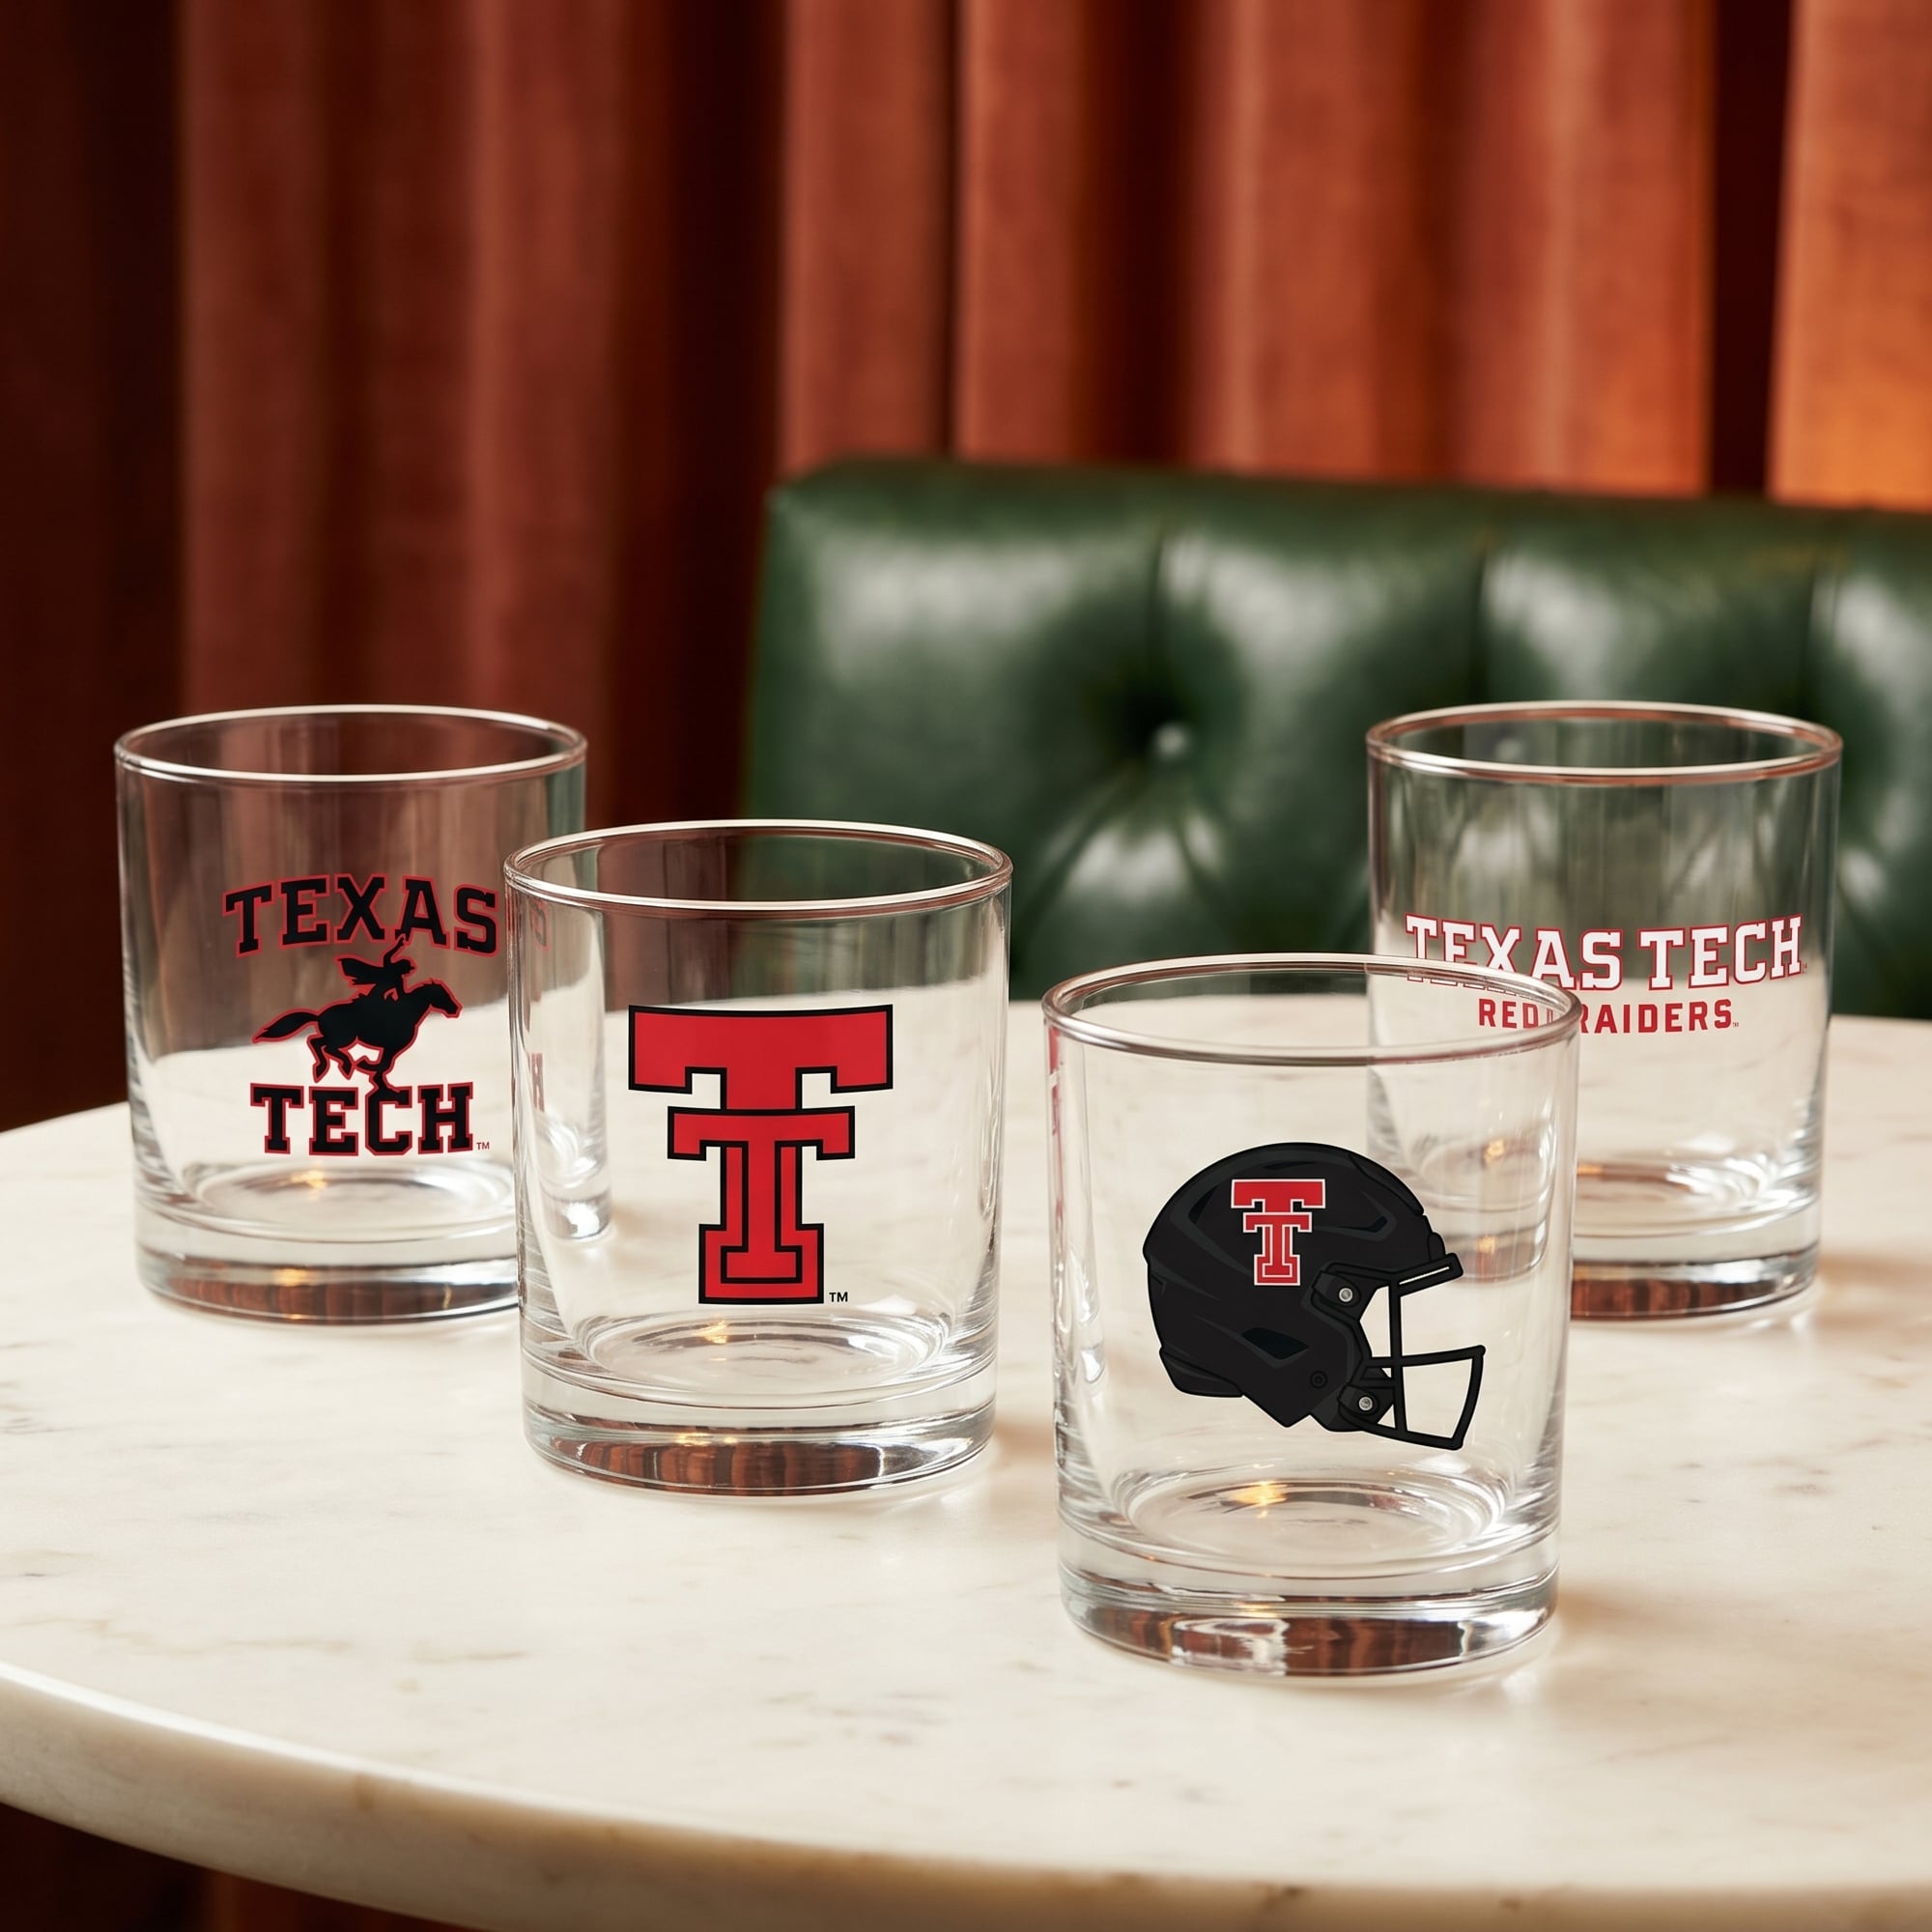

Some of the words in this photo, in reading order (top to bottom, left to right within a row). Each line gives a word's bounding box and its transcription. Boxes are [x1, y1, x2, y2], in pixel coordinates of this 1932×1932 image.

[222, 873, 499, 957] TEXAS
[1406, 913, 1622, 991] TEXAS
[1638, 913, 1804, 991] TECH
[1479, 998, 1540, 1030] RED
[250, 1082, 473, 1156] TECH
